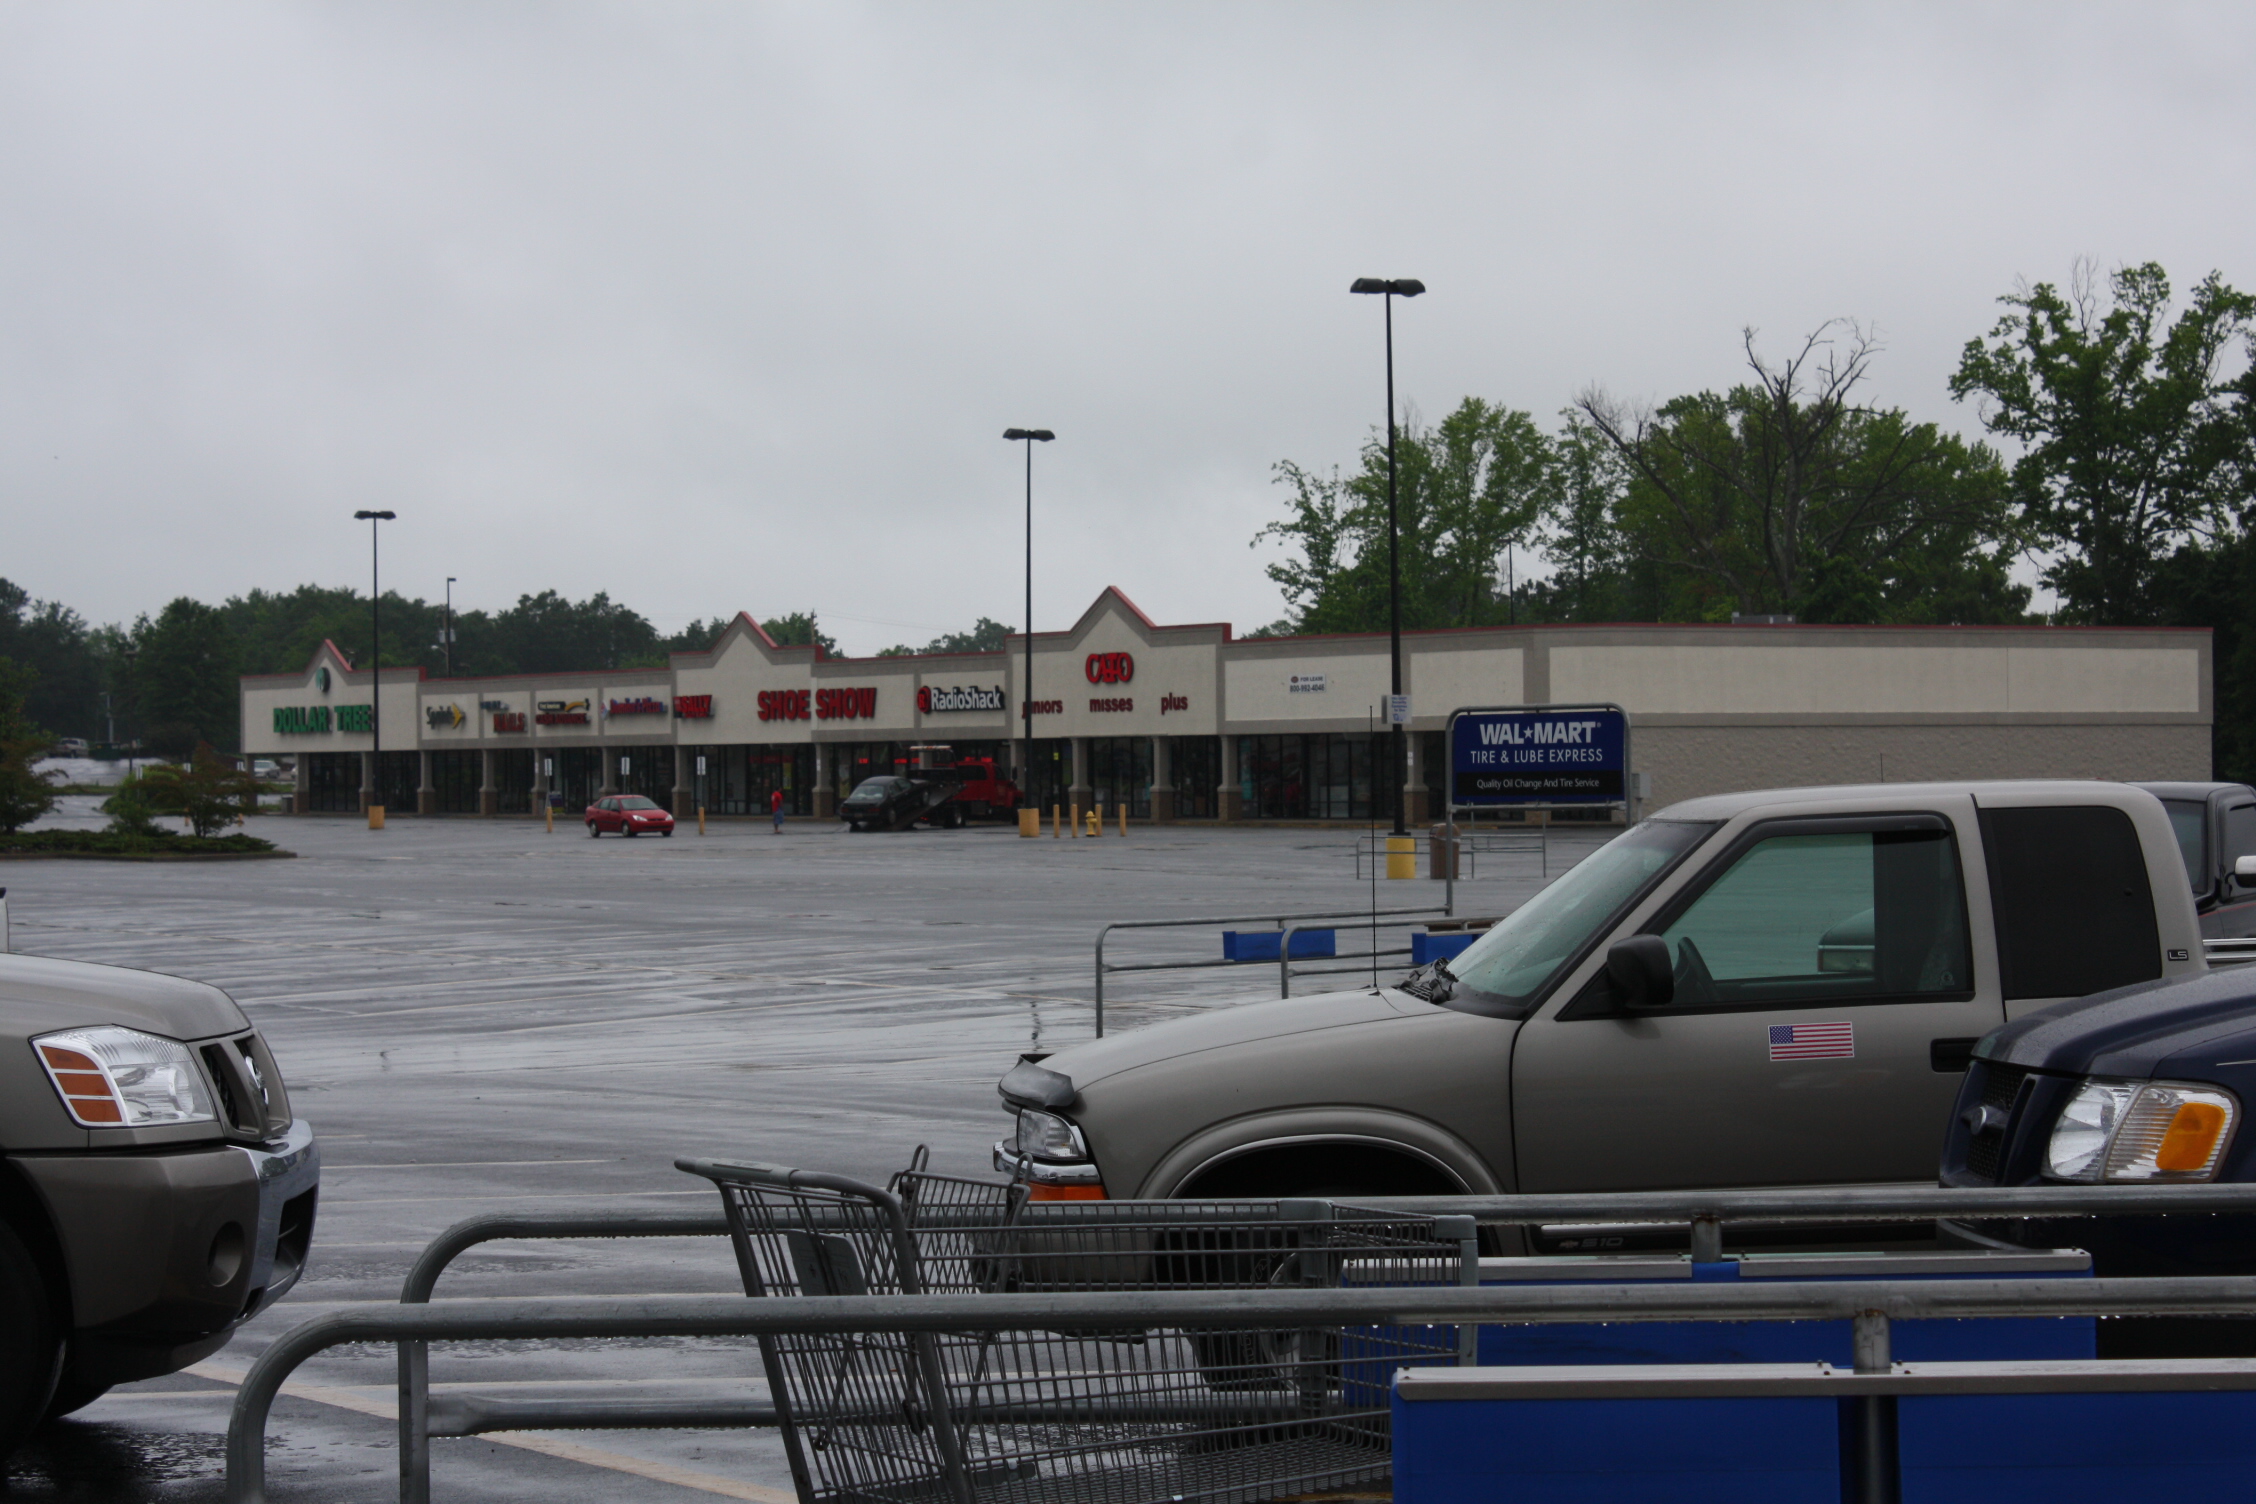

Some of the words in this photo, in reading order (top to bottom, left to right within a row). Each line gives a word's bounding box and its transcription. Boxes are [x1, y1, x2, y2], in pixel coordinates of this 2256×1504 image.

[1085, 652, 1134, 683] CATO
[681, 695, 712, 713] SALLY
[757, 689, 811, 721] SHOE
[816, 687, 877, 719] SHOW
[931, 685, 1003, 711] RadioShack
[1089, 696, 1133, 713] misses
[1160, 692, 1188, 716] plus
[273, 706, 329, 733] DOLLAR
[334, 704, 372, 731] TREE
[1471, 750, 1495, 764] TIRE
[1500, 750, 1509, 763] &
[1514, 749, 1544, 763] LUBE
[1549, 748, 1603, 762] EXPRESS
[1476, 779, 1502, 790] Quality
[1503, 778, 1513, 787] Oil
[1514, 778, 1542, 790] Change
[1543, 778, 1558, 787] And
[1559, 777, 1573, 787] Tire
[1574, 777, 1600, 787] Service
[2168, 951, 2188, 960] LS
[1581, 1237, 1624, 1248] S10
